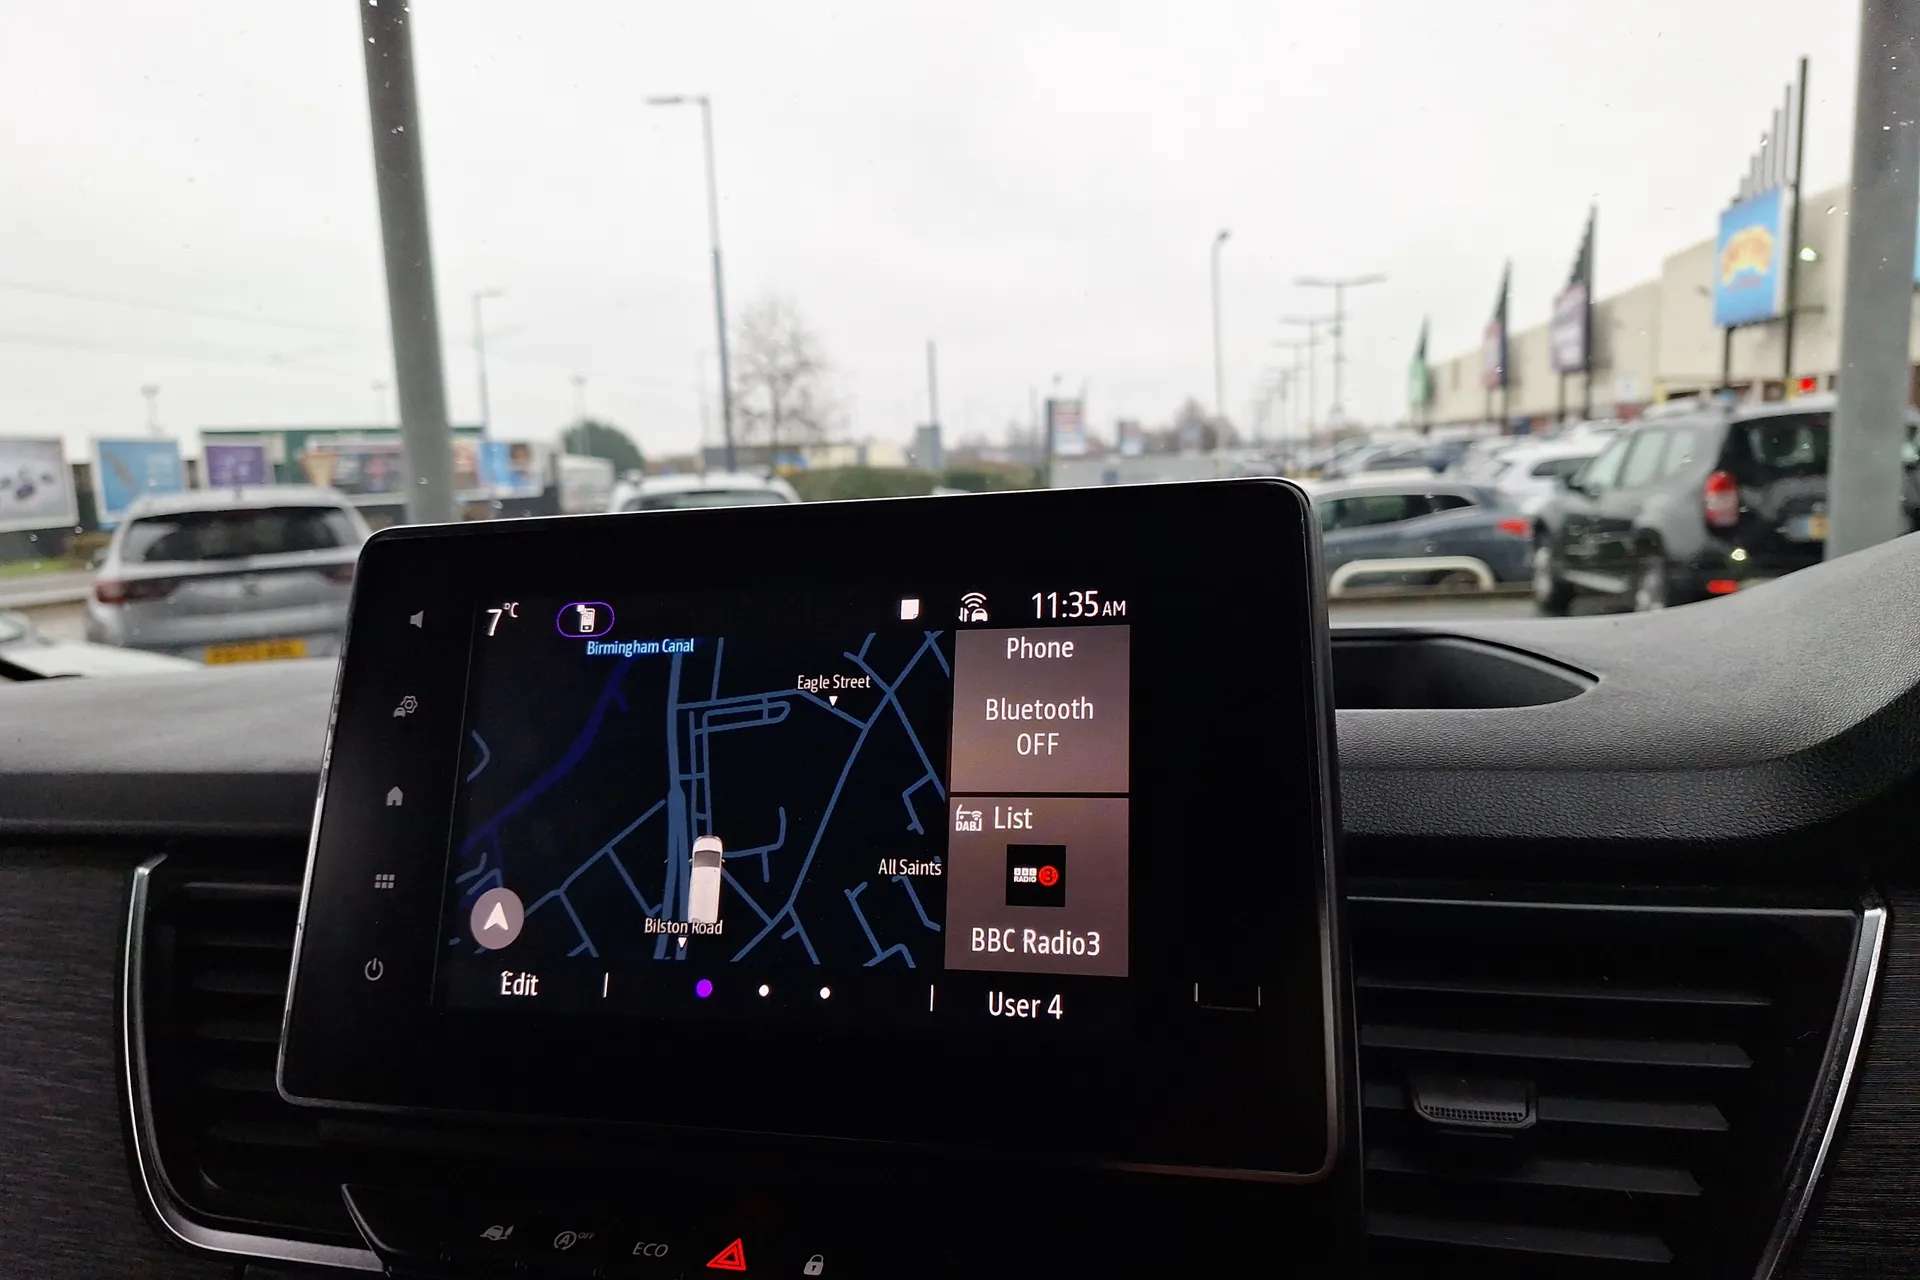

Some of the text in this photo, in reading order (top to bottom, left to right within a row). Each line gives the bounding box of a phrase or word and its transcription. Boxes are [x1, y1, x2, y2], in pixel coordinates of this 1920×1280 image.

[1032, 591, 1126, 618] 11:35 AM
[586, 637, 695, 656] Birmingham Canal
[1007, 637, 1074, 660] Phone
[797, 674, 871, 692] Eagle Street
[985, 696, 1094, 721] Bluetooth
[1016, 733, 1060, 756] OFF
[994, 806, 1033, 830] List
[878, 858, 942, 876] All Saints
[645, 918, 723, 935] Bilston Road
[971, 927, 1100, 956] BBC Radio3
[500, 971, 539, 996] Edit
[988, 991, 1063, 1020] User 4
[632, 1241, 669, 1257] ECO
